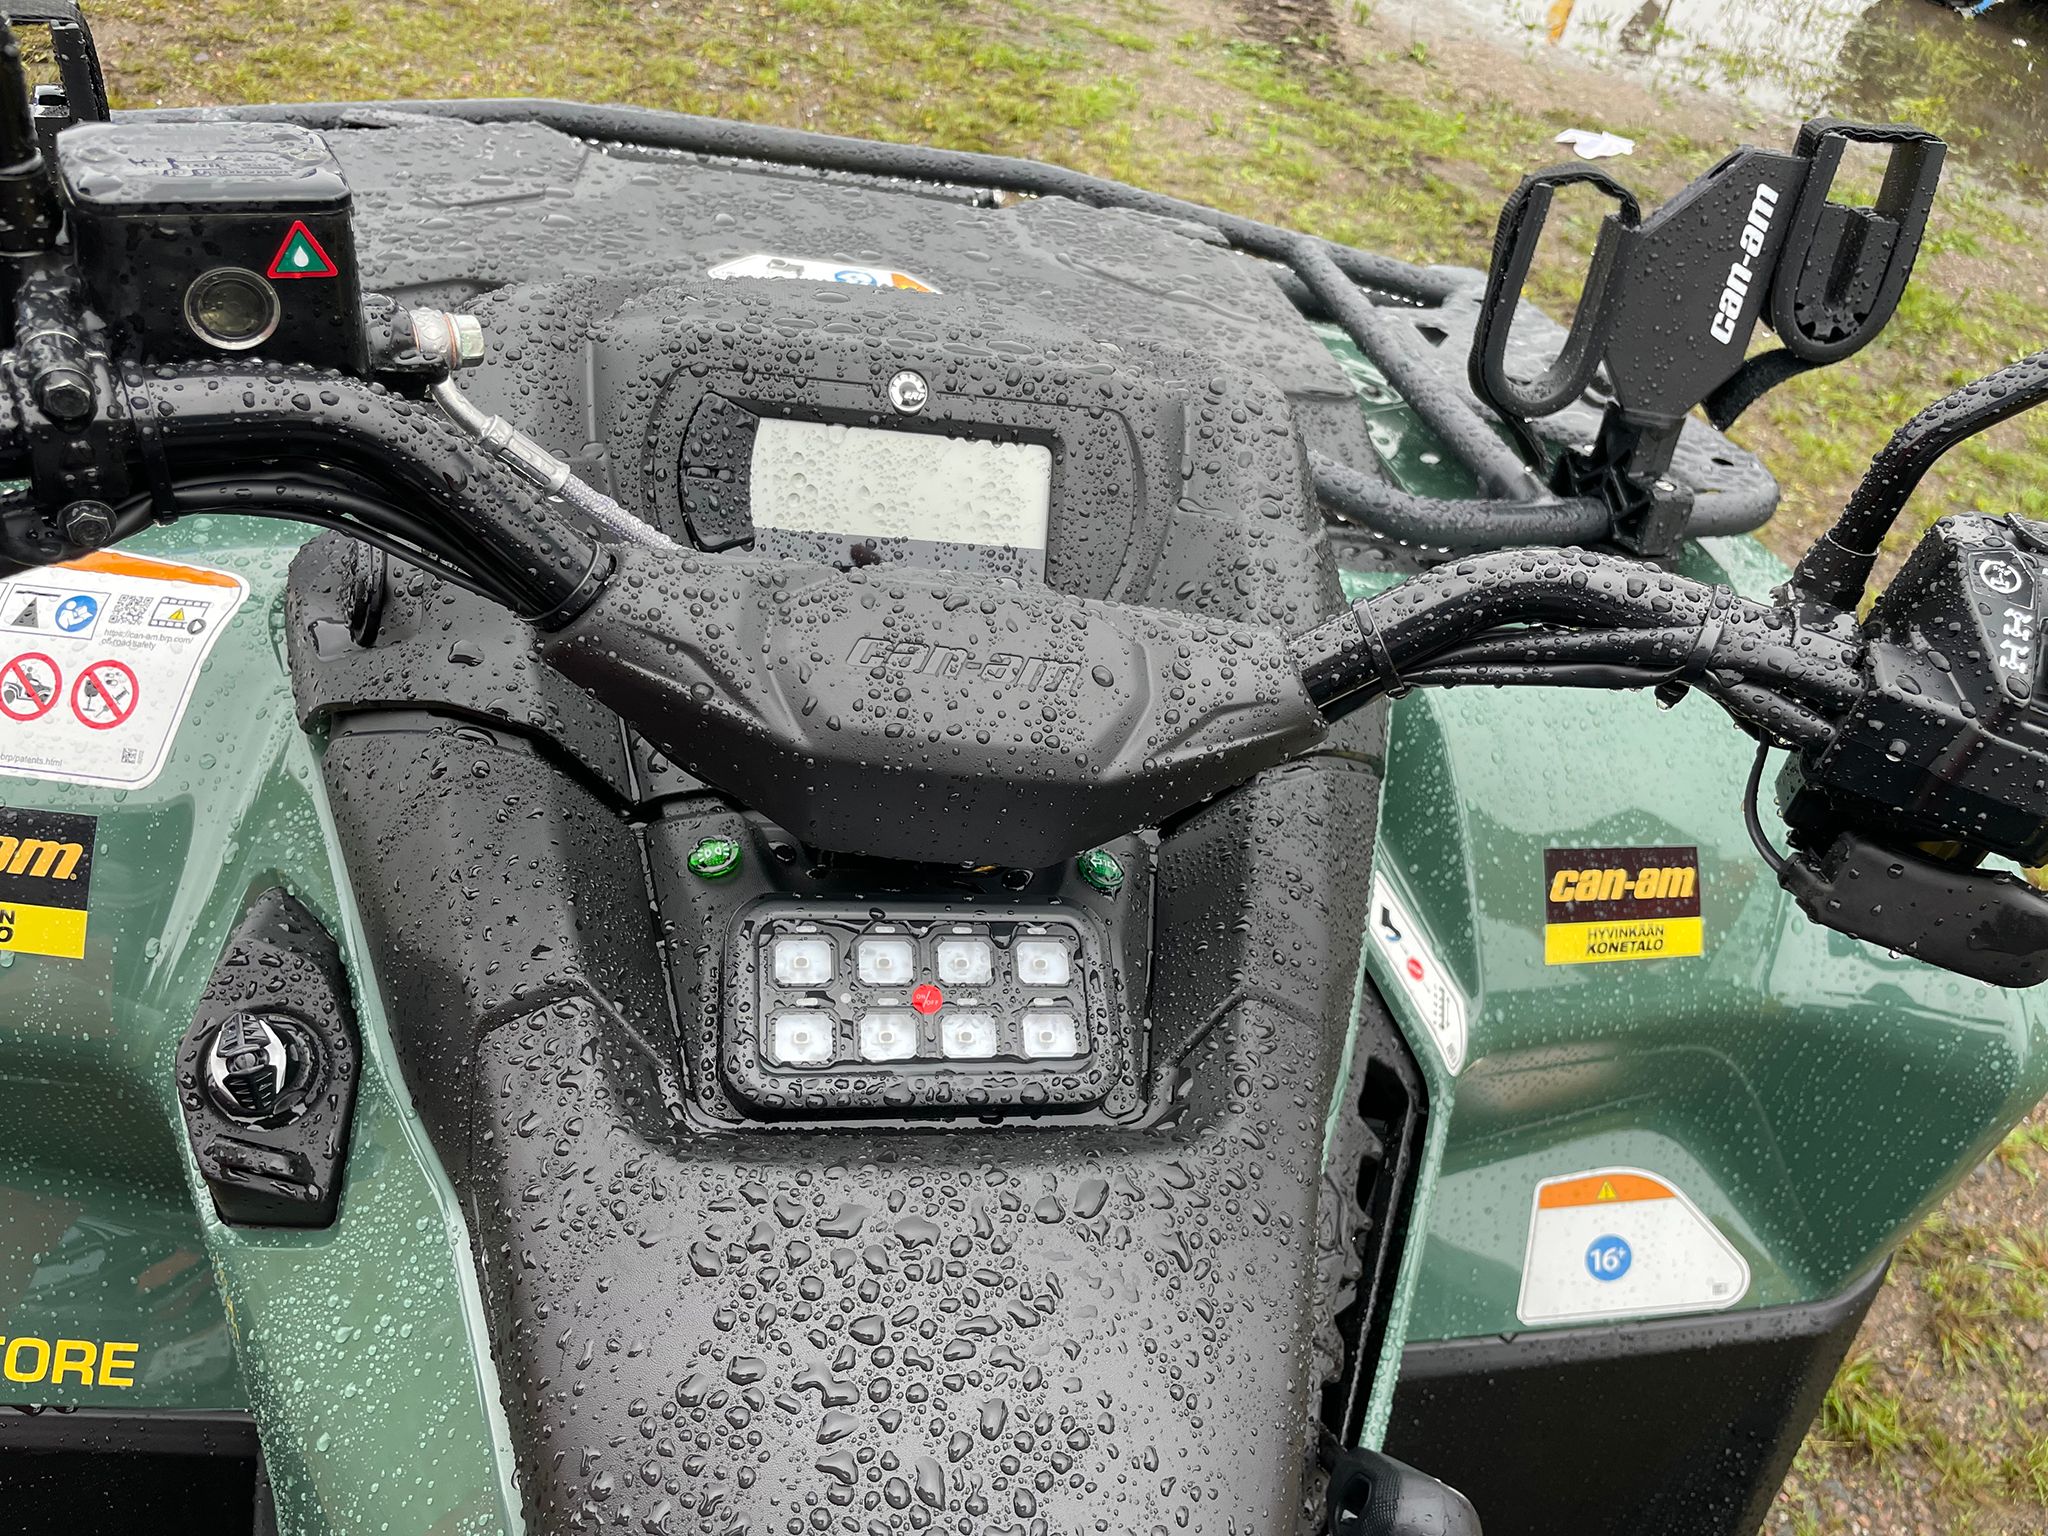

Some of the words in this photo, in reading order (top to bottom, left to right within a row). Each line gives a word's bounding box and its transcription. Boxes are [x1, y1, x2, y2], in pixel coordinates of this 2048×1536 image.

[1710, 183, 1779, 345] can-am
[846, 637, 1082, 692] can-am
[1549, 866, 1696, 902] can-am
[1586, 939, 1664, 955] KONETALO
[1587, 924, 1665, 940] HYVINKÄÄN
[0, 1336, 140, 1387] ORE
